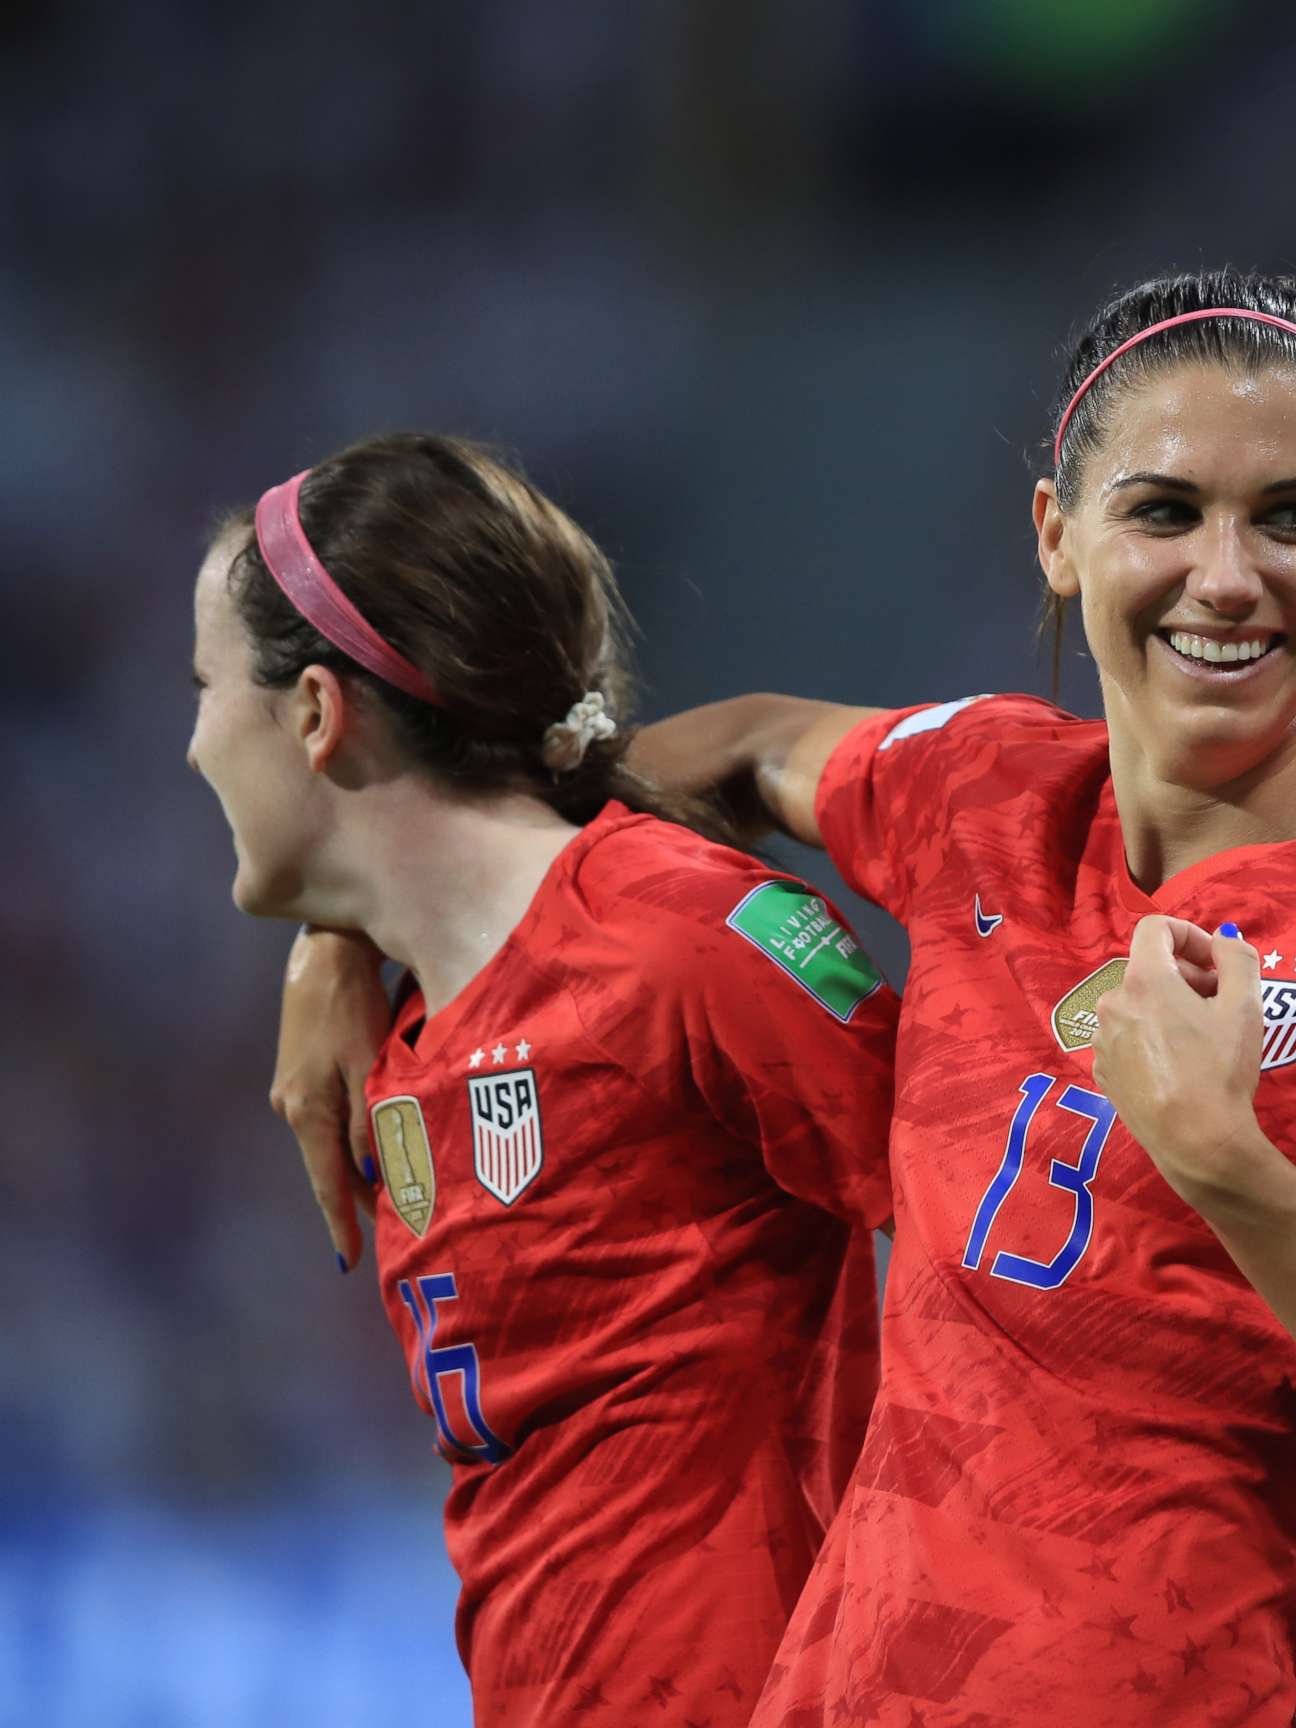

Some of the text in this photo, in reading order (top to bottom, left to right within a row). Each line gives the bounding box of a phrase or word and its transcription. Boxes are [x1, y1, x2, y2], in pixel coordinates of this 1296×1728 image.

[769, 898, 820, 949] LIVING
[784, 914, 832, 960] FOOTBAL
[474, 1078, 532, 1130] USA
[961, 1072, 1118, 1291] 13
[397, 1272, 514, 1466] 16
